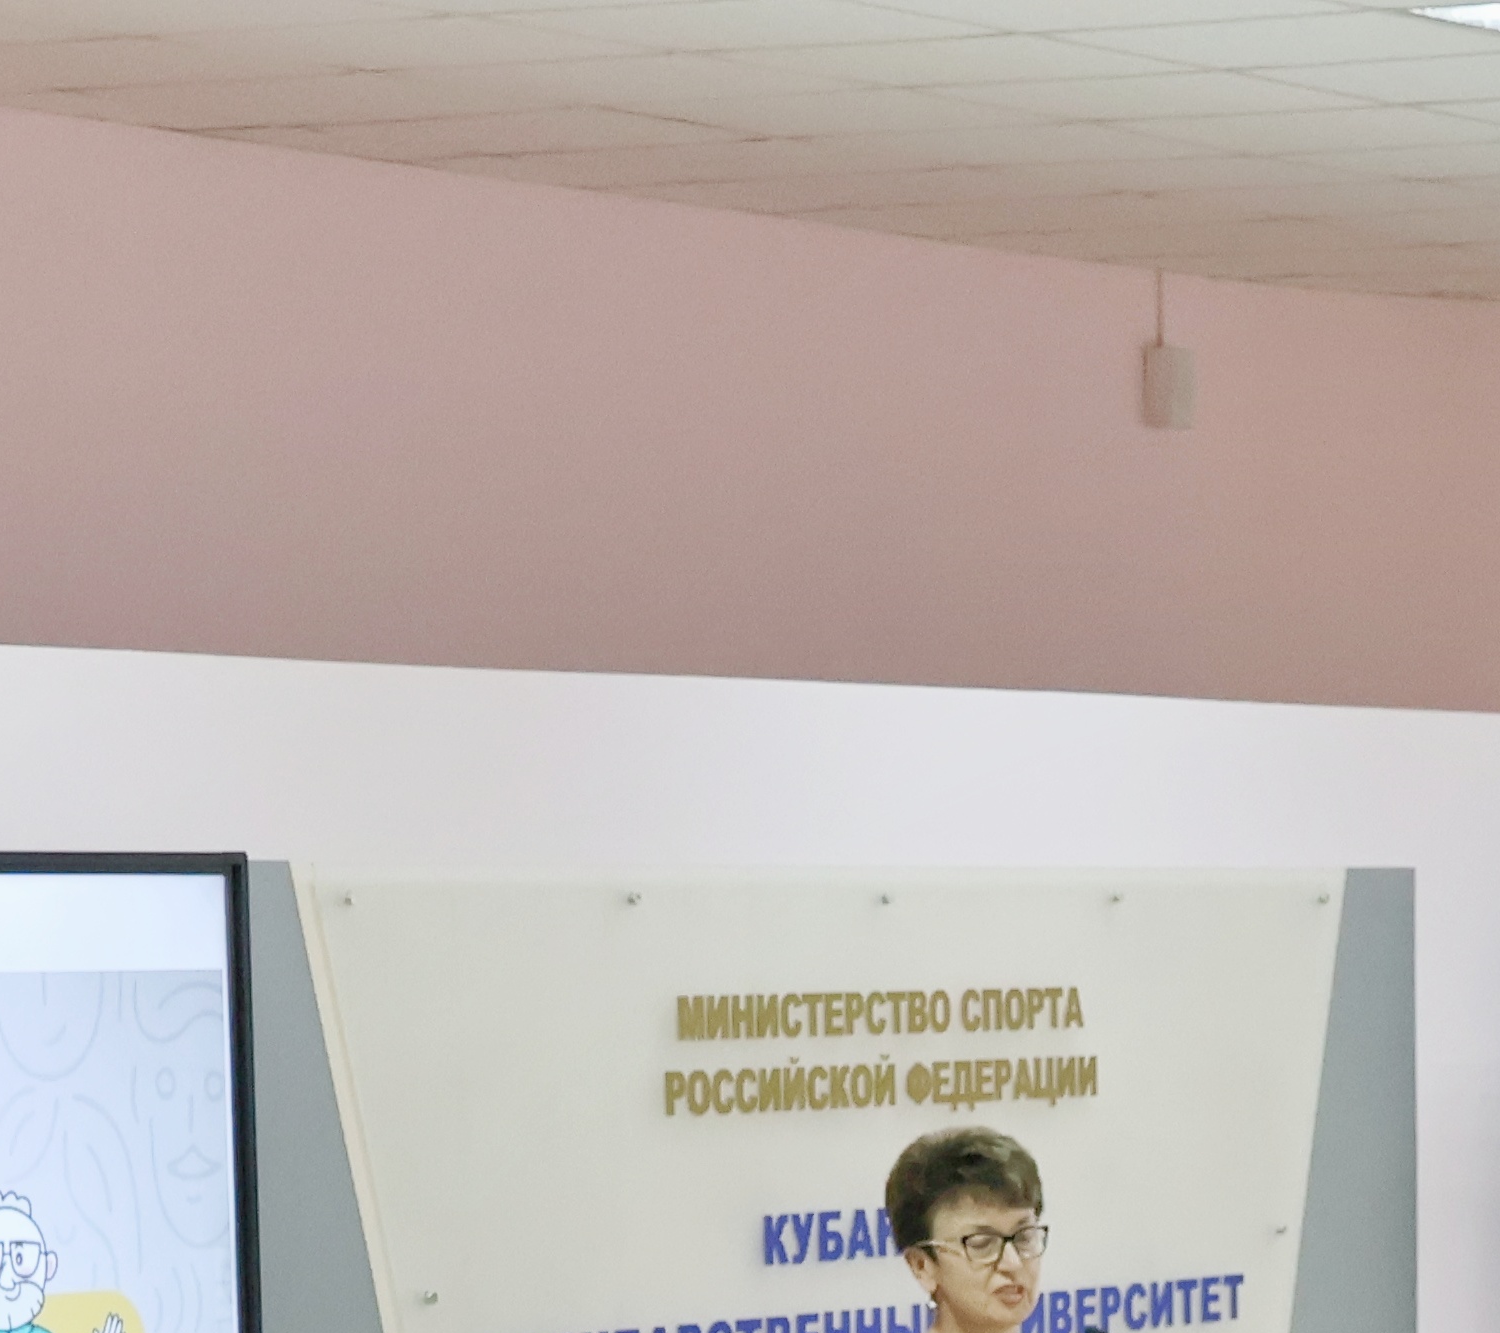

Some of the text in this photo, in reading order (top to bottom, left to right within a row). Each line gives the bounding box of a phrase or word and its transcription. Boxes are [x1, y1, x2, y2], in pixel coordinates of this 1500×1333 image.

[676, 986, 1085, 1042] МИНИСТЕРСТВО СПОРТА
[664, 1053, 1099, 1117] РОССИЙСКОЙ ФЕДЕРАЦИИ
